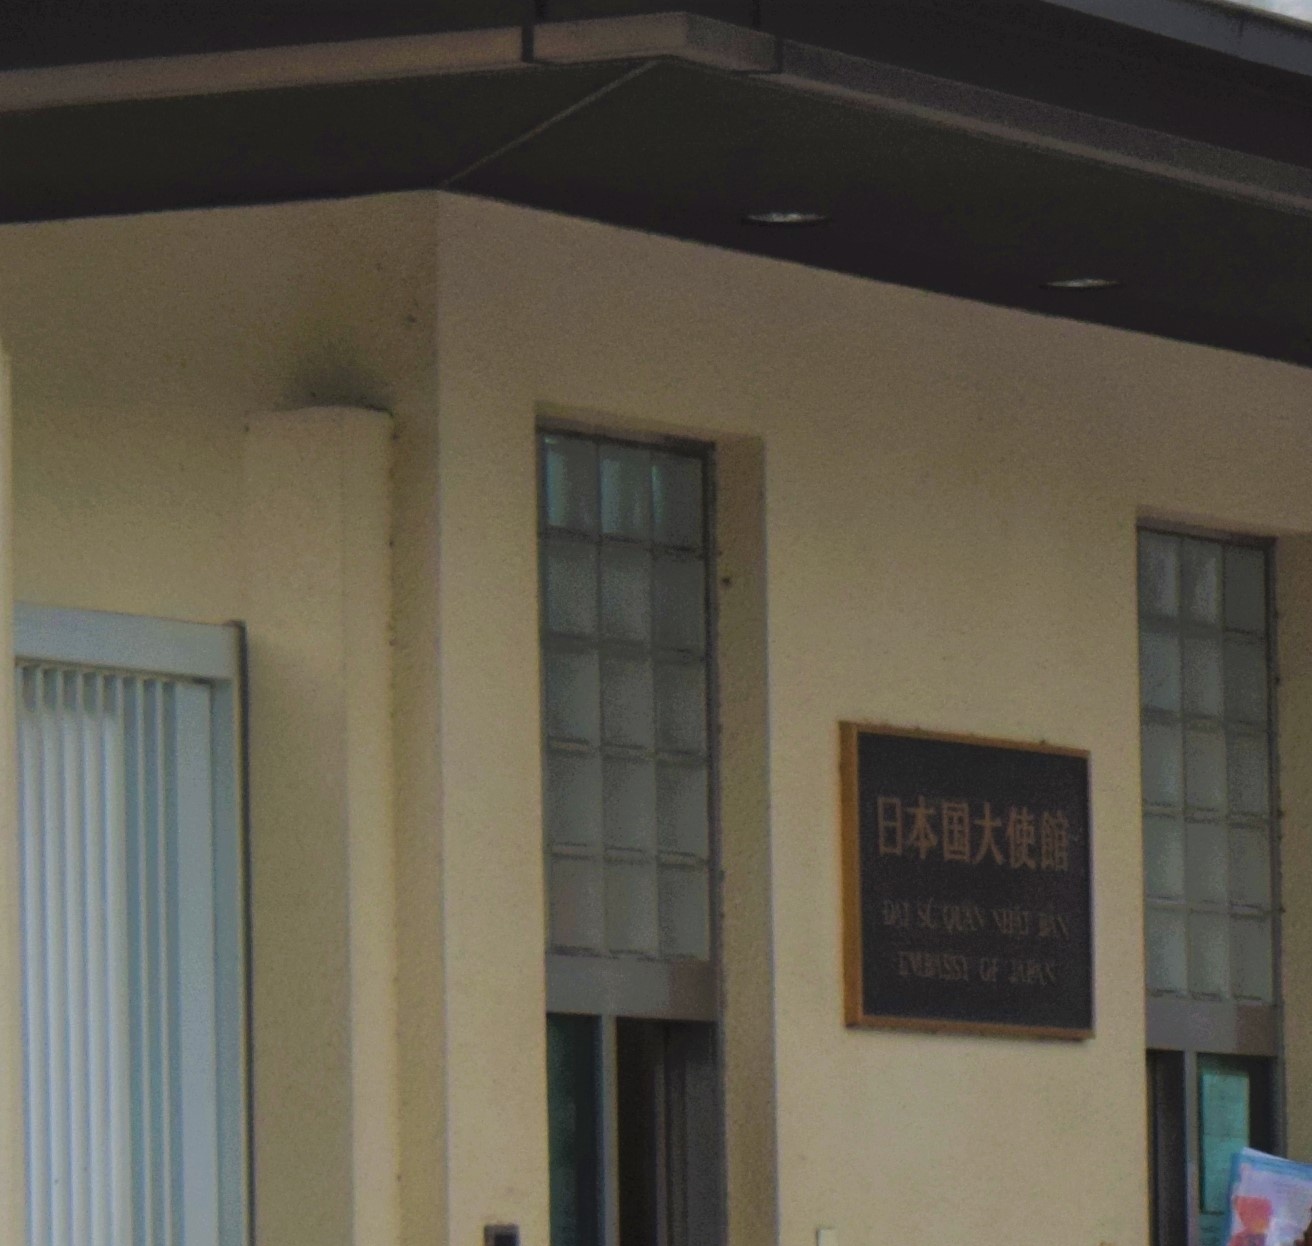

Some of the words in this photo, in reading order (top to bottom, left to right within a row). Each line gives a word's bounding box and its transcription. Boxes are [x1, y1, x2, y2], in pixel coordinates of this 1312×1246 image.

[877, 795, 1070, 871] 日本国大使館
